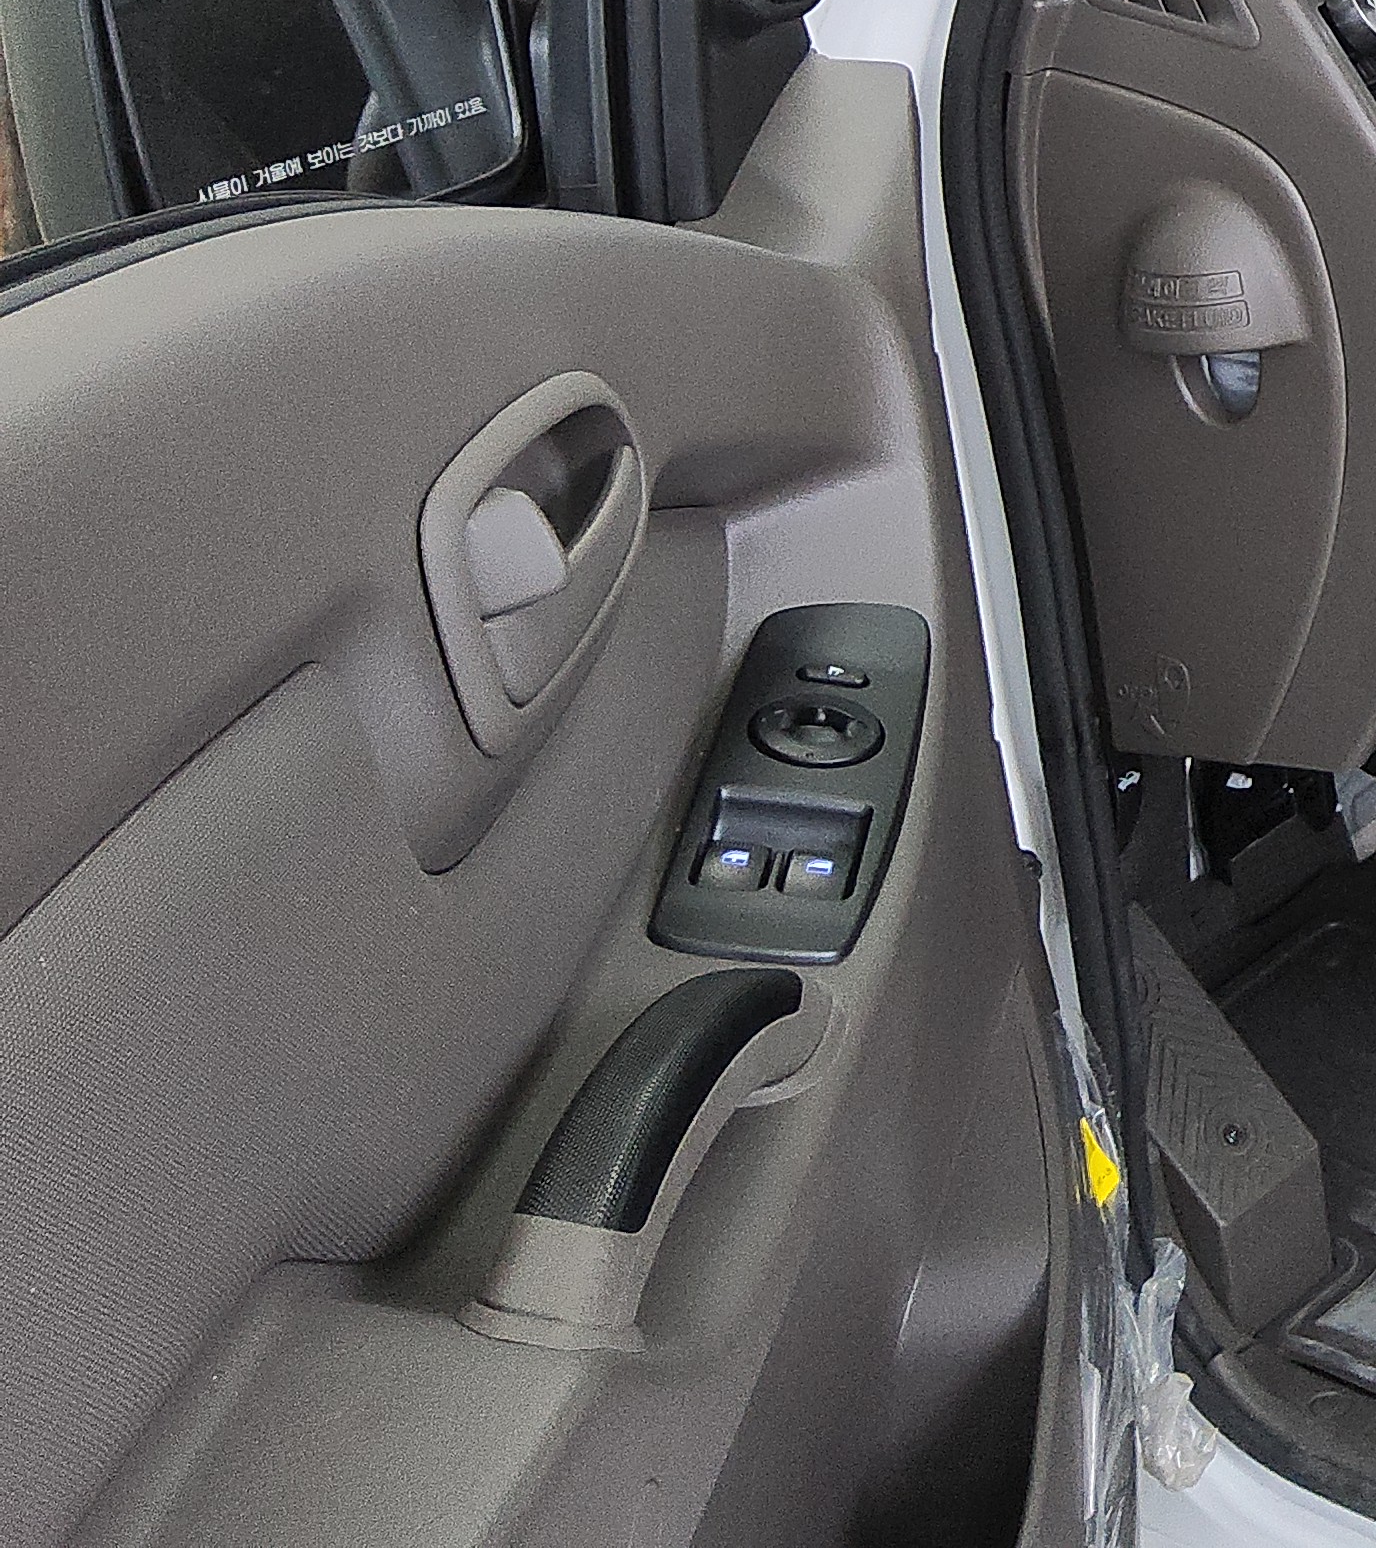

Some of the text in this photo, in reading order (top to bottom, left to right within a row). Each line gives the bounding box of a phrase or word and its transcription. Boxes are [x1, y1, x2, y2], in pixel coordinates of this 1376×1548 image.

[198, 96, 488, 202] 사물이 거울에 보이는 것보다 가까이 있음
